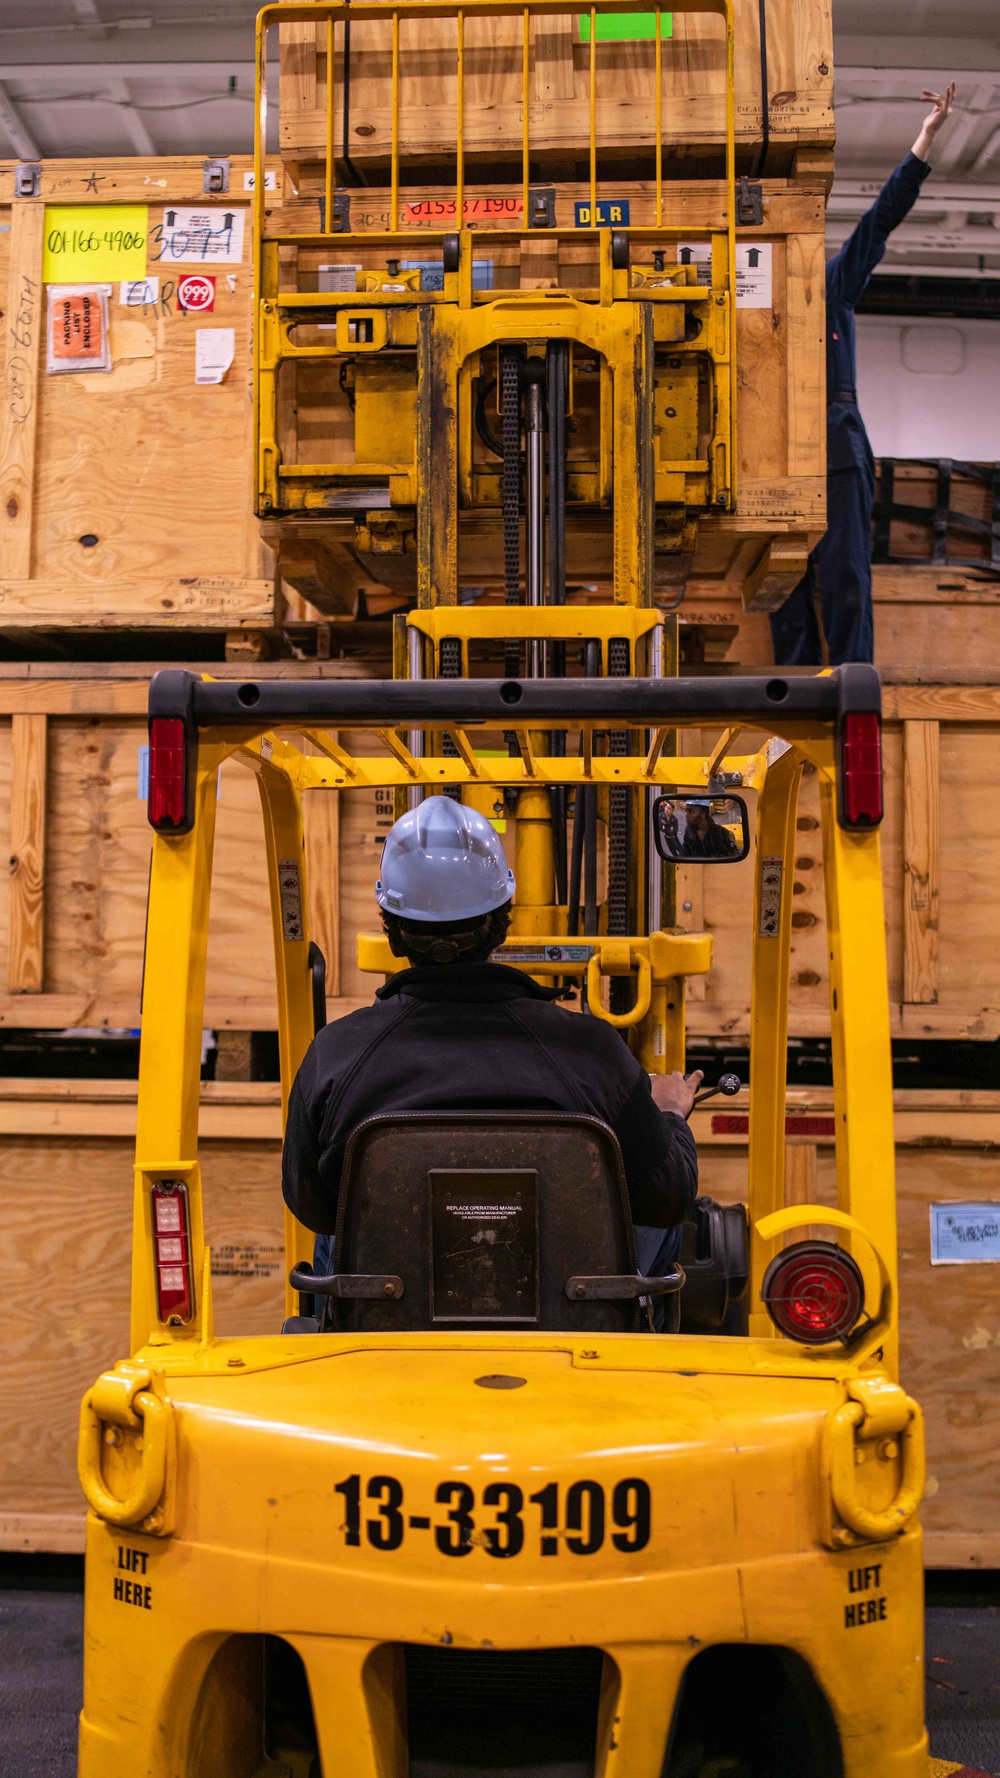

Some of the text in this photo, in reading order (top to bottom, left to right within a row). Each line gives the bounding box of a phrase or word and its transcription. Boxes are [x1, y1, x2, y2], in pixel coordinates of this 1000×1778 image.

[48, 229, 145, 255] 01-166-4906
[183, 285, 209, 302] 999
[63, 301, 71, 346] PACKING
[82, 296, 91, 348] ENCLOSED
[334, 1474, 651, 1558] 13-33109
[118, 1545, 149, 1575] LIFT
[113, 1577, 152, 1610] HERE
[848, 1563, 882, 1593] LIFT
[844, 1597, 887, 1628] HERE
